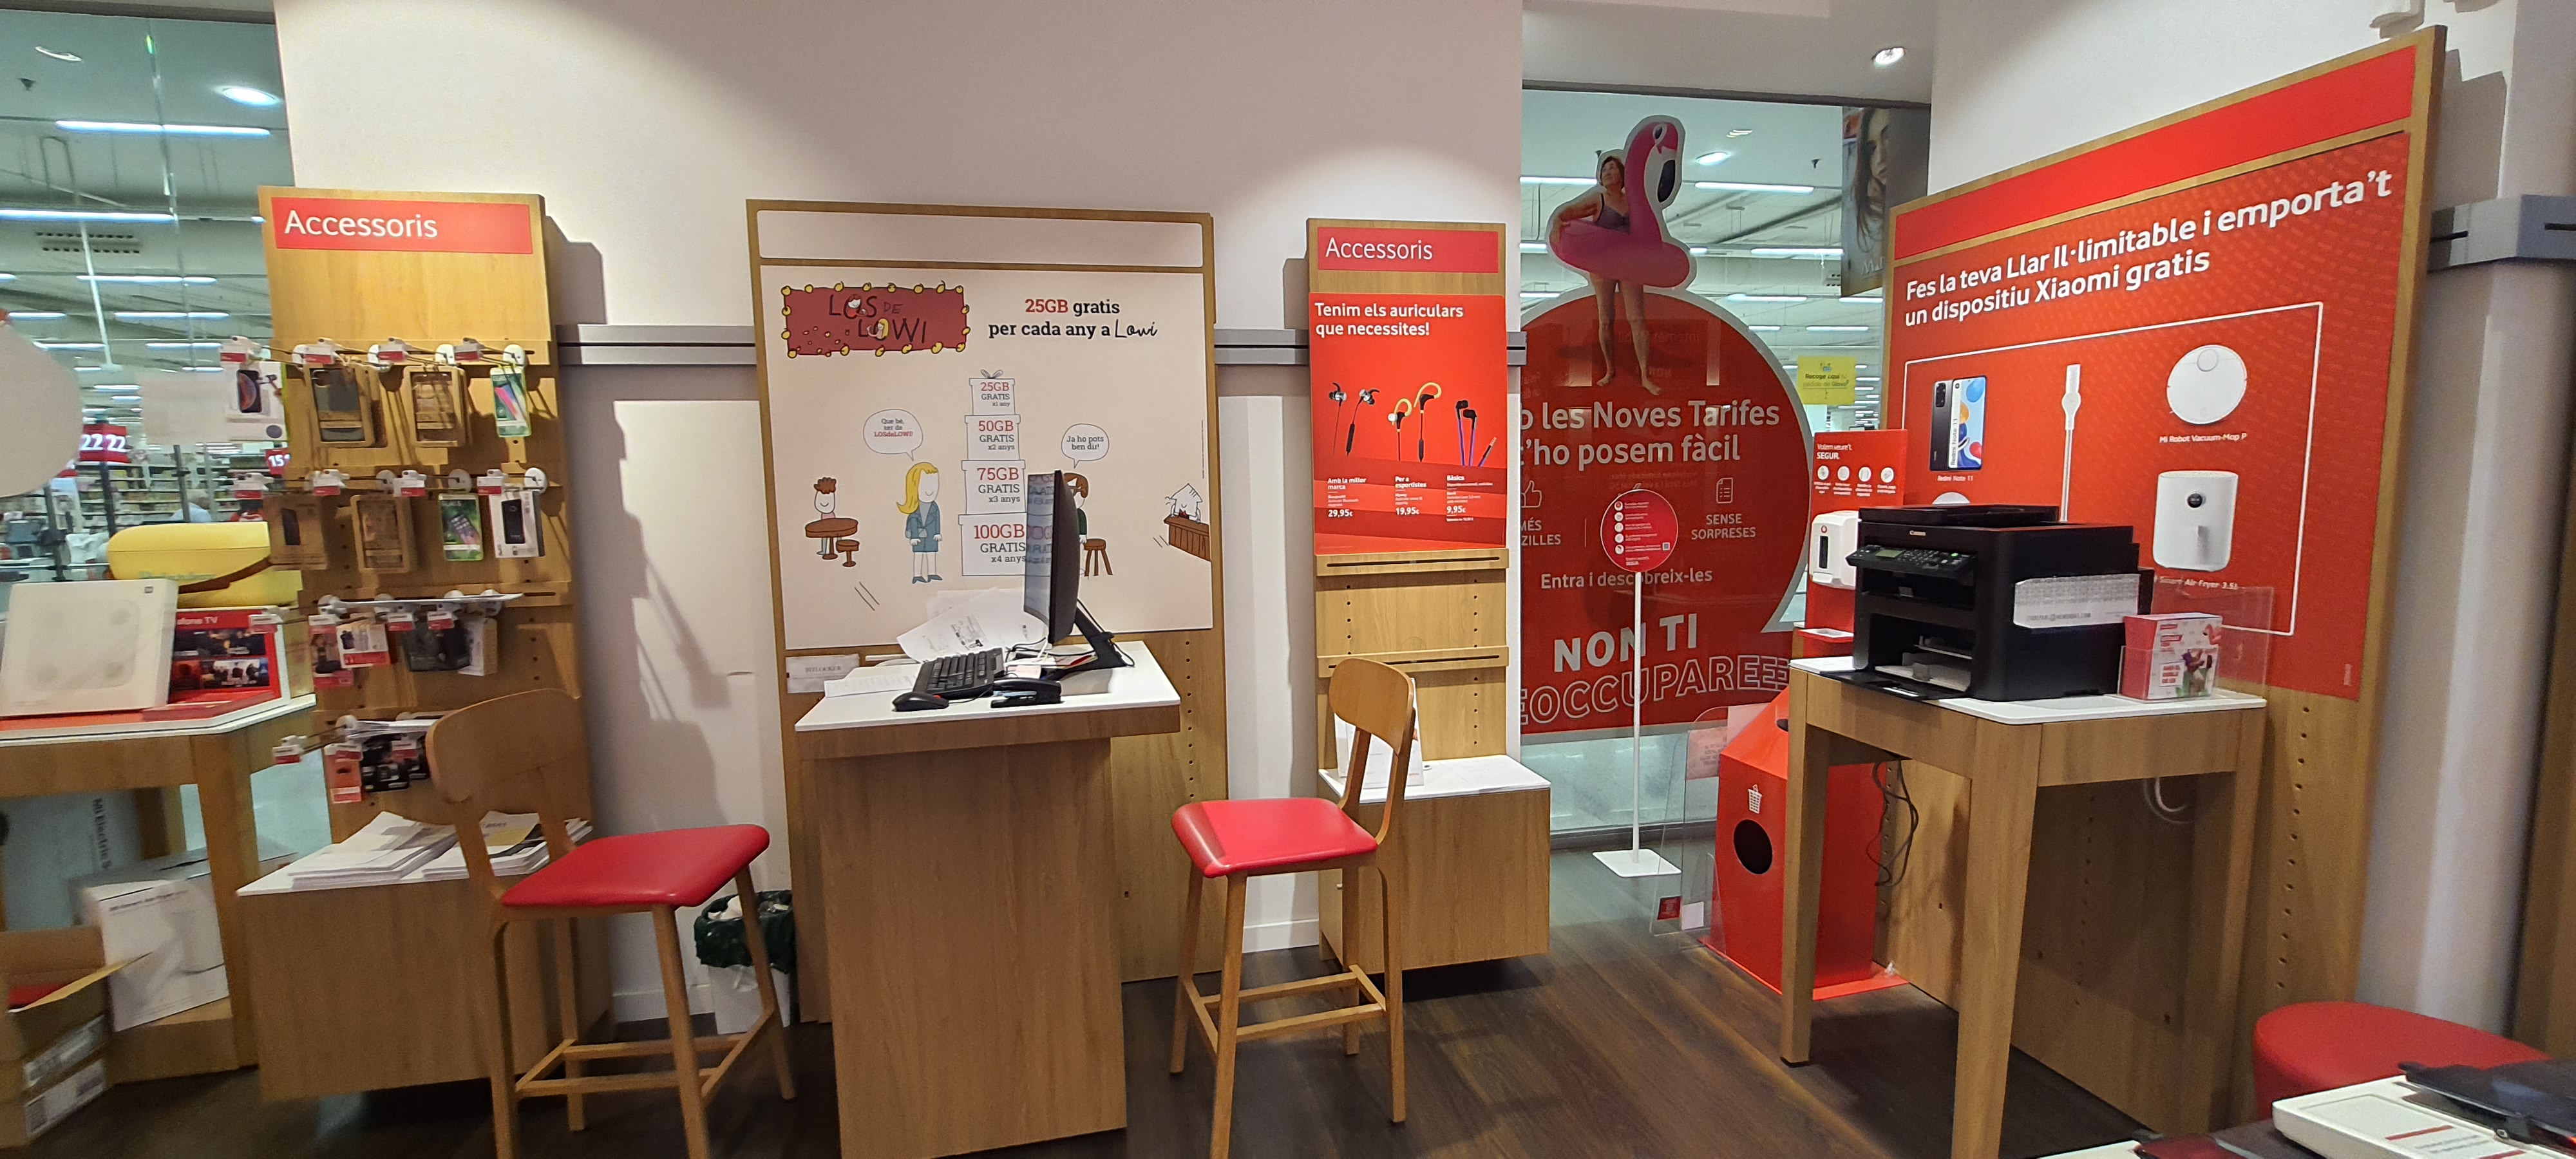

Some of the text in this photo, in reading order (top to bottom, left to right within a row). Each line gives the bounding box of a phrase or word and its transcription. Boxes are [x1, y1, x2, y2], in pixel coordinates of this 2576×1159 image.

[284, 210, 438, 238] Accessoris
[1907, 280, 1936, 301] Fes
[1940, 274, 1956, 294] la
[1960, 265, 2002, 289] teva
[2007, 254, 2050, 278] Llar
[2203, 210, 2211, 236] i
[2217, 169, 2392, 232] emporta't
[1325, 236, 1434, 260] Accessoris
[1905, 249, 2210, 326] un dispositiu Xiaomi gratis
[829, 294, 904, 319] LOS DE
[1025, 298, 1121, 317] 25GB gratis
[1314, 302, 1464, 317] Tenim els auriculars
[858, 317, 927, 344] LOWI
[988, 319, 1158, 339] per cada any a Lowi
[1316, 322, 1430, 338] que necessites!
[980, 382, 1010, 391] 25GB
[1542, 402, 1585, 429] les
[1593, 400, 1682, 429] Noves
[1688, 399, 1780, 427] Tarifes
[978, 420, 1014, 432] 50GB
[80, 434, 126, 453] 22 22
[1088, 436, 1104, 444] pots
[1578, 443, 1673, 472] posem
[1681, 434, 1741, 462] fàcil
[977, 467, 1019, 481] 75GB
[978, 484, 1020, 493] GRATIS
[1001, 496, 1021, 504] anys
[1705, 513, 1743, 525] SENSE
[974, 524, 1025, 540] 100GB
[1691, 527, 1756, 540] SORPRESES
[980, 542, 1026, 553] GRATIS
[1540, 567, 1713, 589] Entra i descbreix-les
[1554, 613, 1698, 673] NON TI
